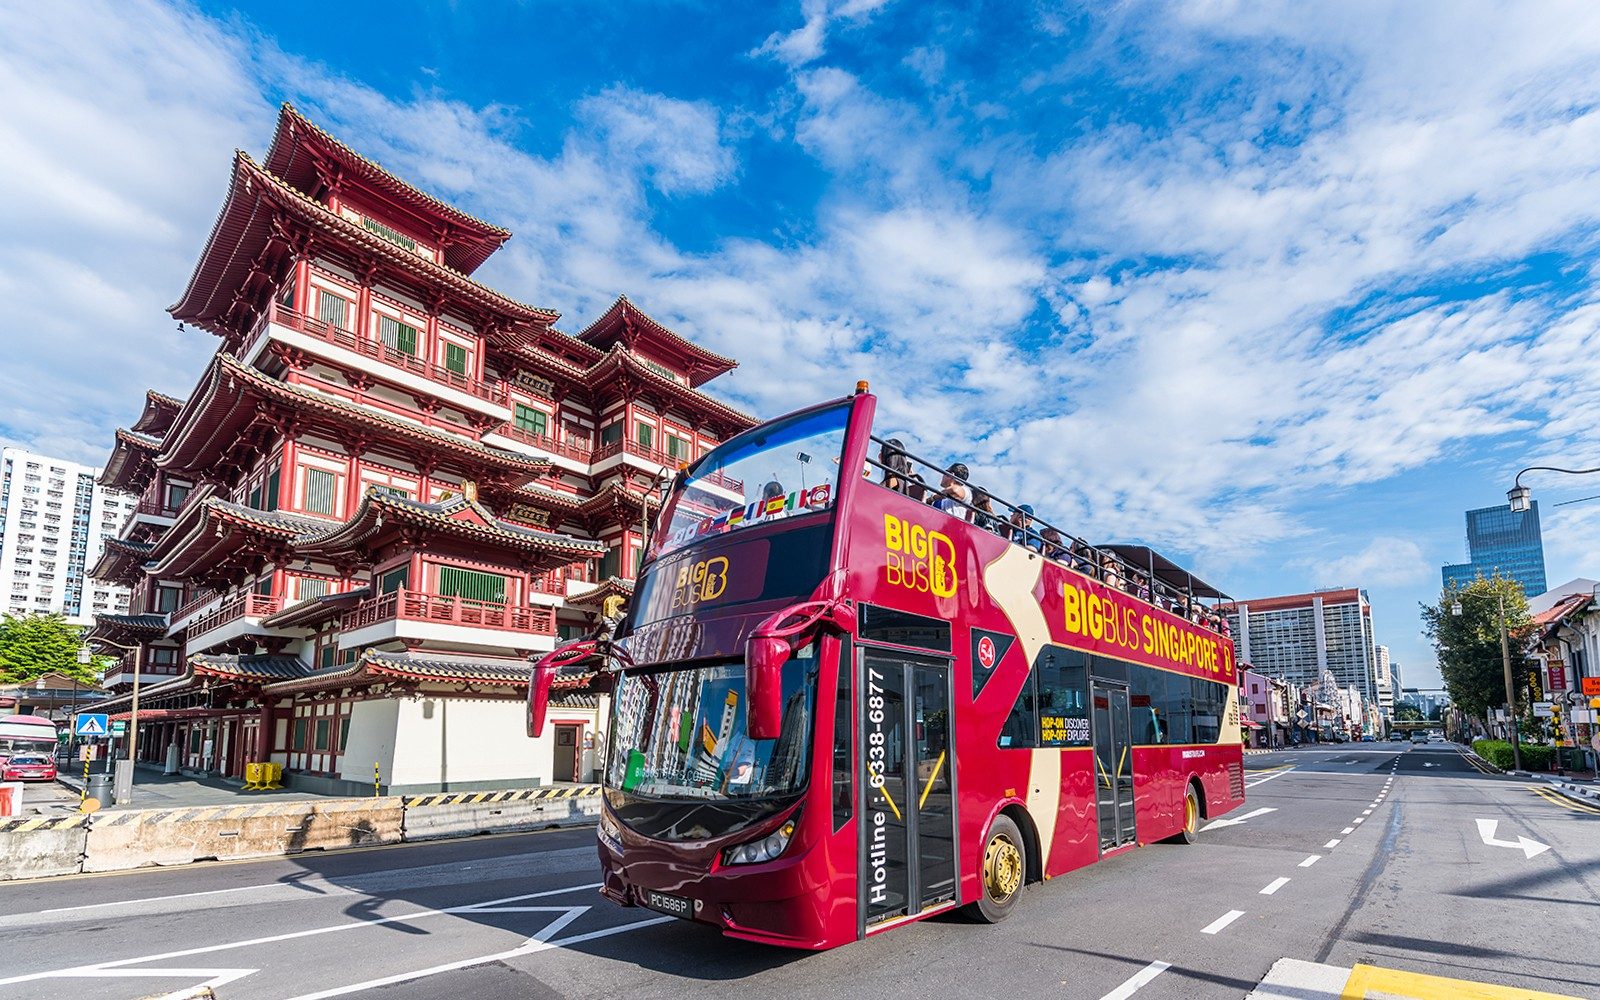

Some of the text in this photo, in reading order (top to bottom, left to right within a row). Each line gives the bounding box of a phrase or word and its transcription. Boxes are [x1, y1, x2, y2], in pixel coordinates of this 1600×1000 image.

[884, 513, 927, 559] BIG
[677, 561, 706, 589] BIG
[887, 551, 929, 593] BUS
[672, 584, 702, 608] BUS
[980, 643, 993, 662] 54
[1142, 614, 1219, 673] SINGAPORE
[868, 667, 885, 789] 6338-6877
[1041, 716, 1090, 730] HOP-ON DISCOVER
[1042, 729, 1090, 741] HOP-OFF EXPLORE
[871, 811, 887, 903] Hotline
